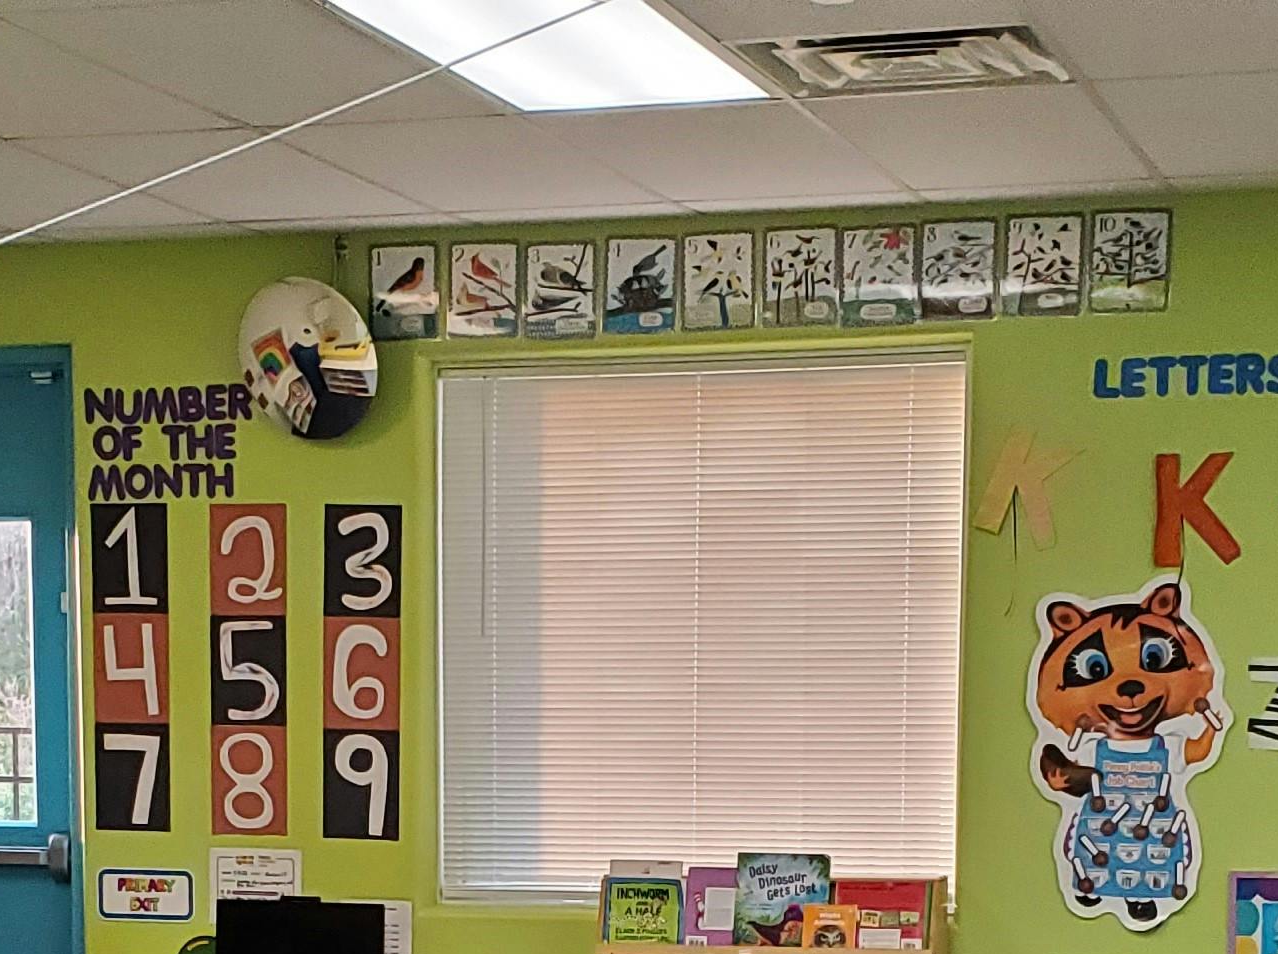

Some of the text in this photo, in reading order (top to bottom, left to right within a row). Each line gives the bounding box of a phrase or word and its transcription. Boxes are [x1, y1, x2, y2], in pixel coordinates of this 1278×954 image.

[84, 384, 253, 424] NUMBER
[93, 423, 237, 461] OF THE
[88, 463, 234, 501] MONTH
[972, 424, 1085, 552] K
[1153, 451, 1241, 568] K
[104, 506, 393, 611] 1 2 3
[103, 620, 388, 721] 4 5 6
[103, 732, 388, 836] 7 8 9
[118, 878, 175, 892] PRIMARY
[749, 864, 778, 878] Daisy
[758, 873, 807, 889] Dinosaur
[130, 897, 159, 911] EXIT
[616, 887, 669, 900] INCHWORM
[767, 882, 817, 901] Gets Lost
